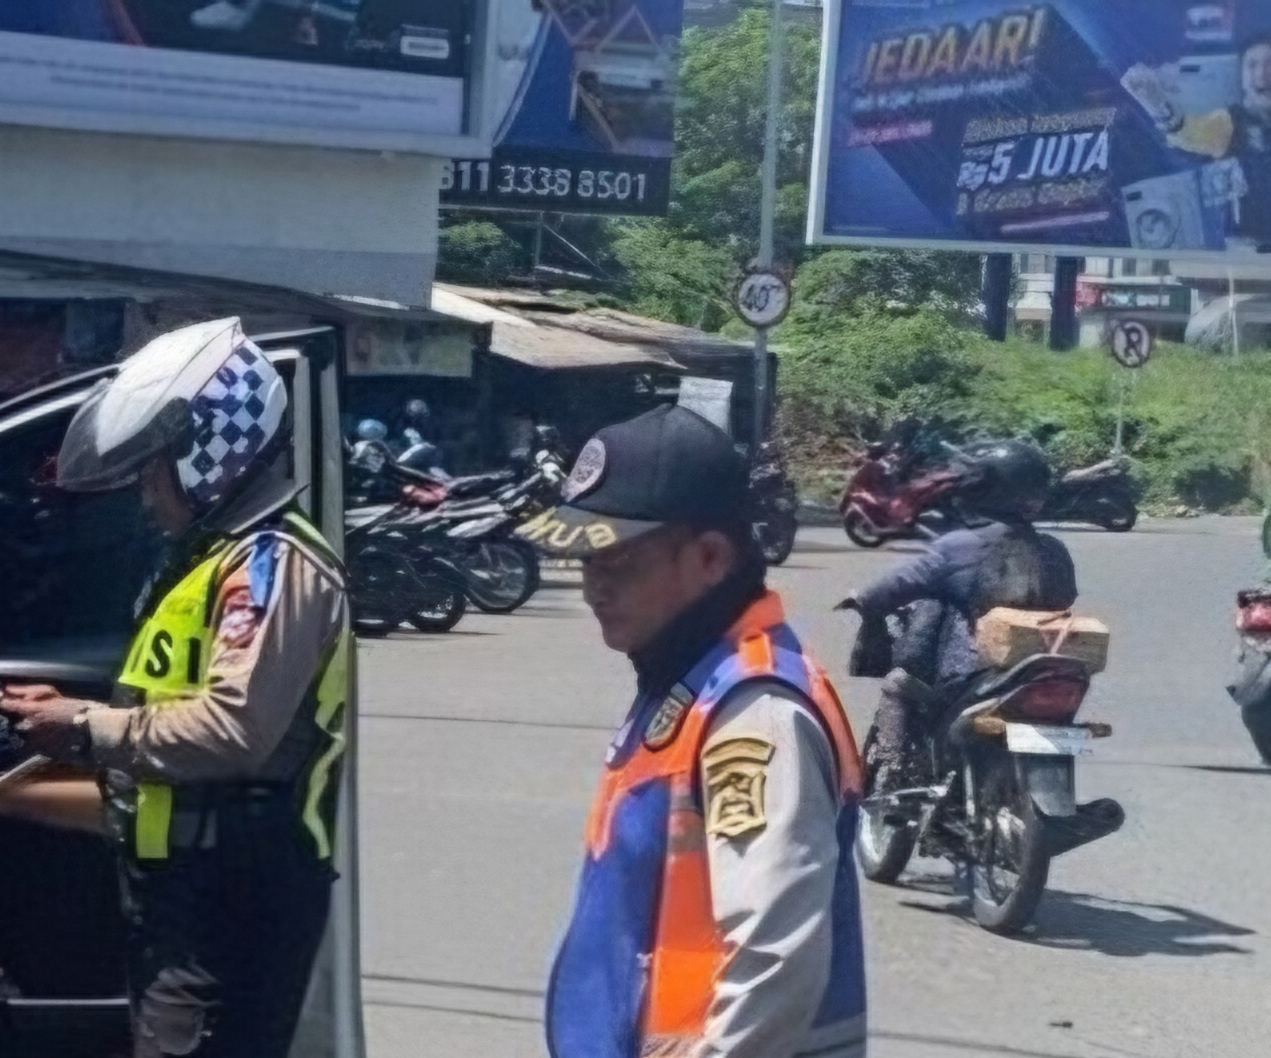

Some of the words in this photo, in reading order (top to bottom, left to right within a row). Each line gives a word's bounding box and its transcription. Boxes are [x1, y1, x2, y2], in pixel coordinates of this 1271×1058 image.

[1016, 126, 1109, 181] JUTA
[498, 164, 572, 198] 3338
[577, 170, 646, 201] 8501
